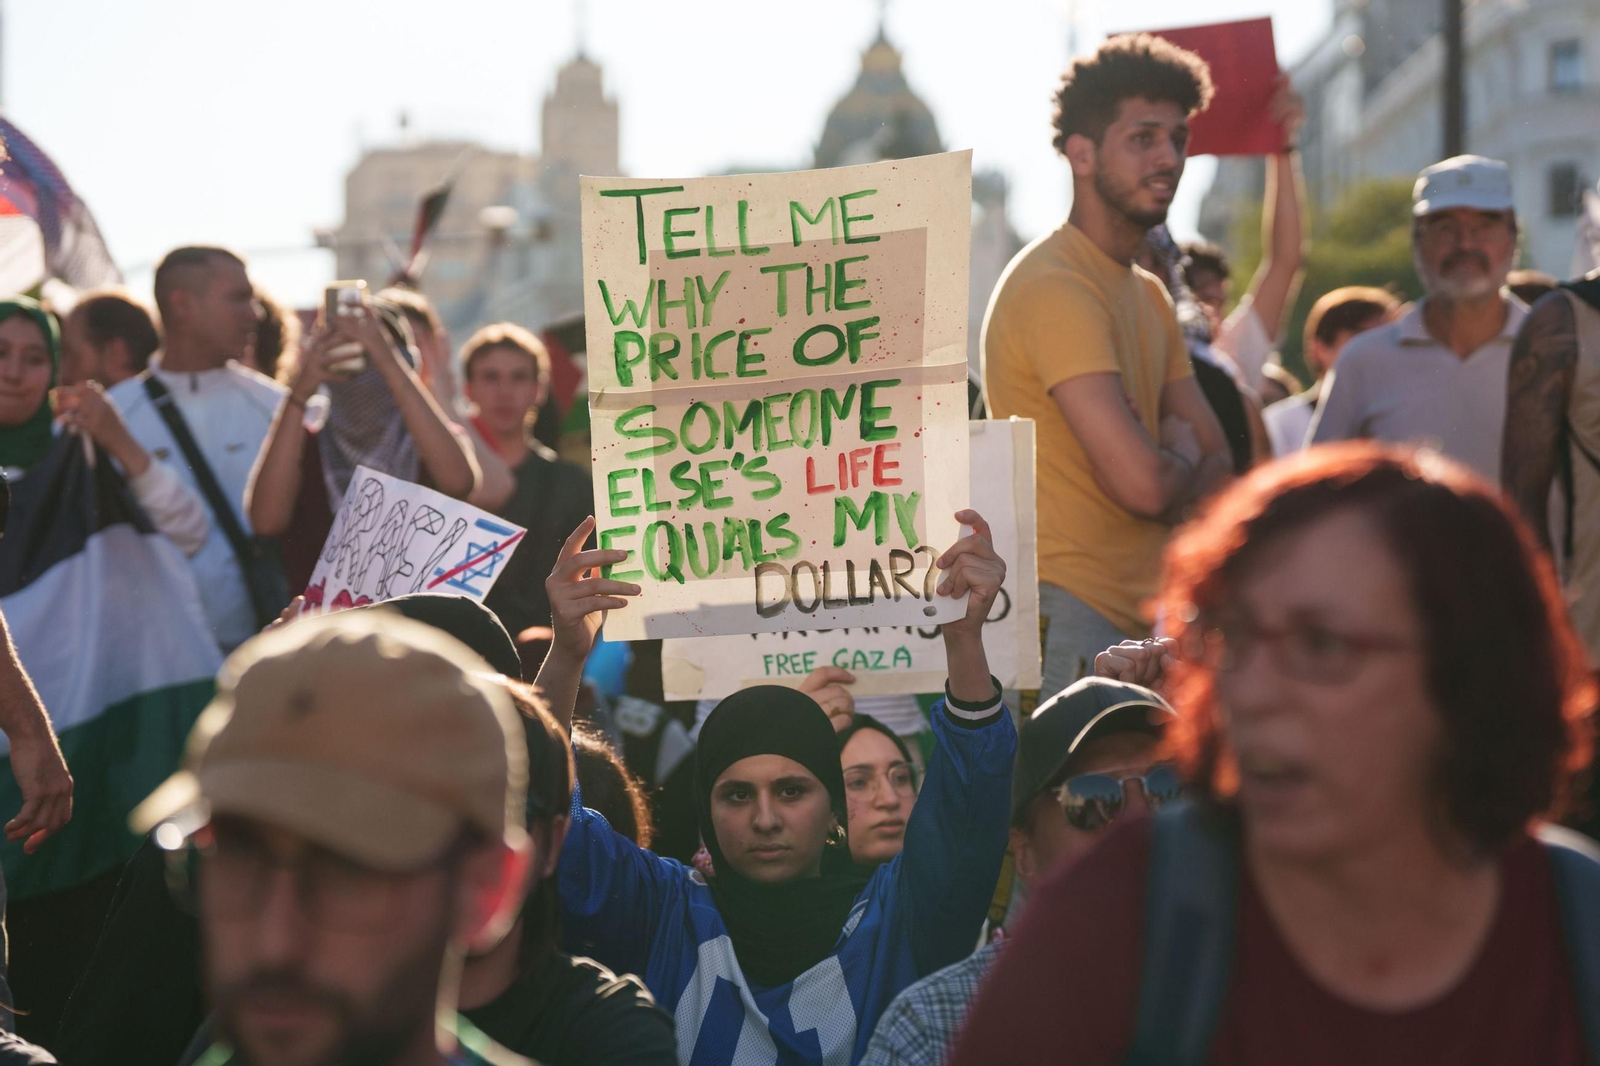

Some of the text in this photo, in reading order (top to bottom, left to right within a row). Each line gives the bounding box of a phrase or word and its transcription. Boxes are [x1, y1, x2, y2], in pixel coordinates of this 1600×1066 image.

[600, 186, 880, 265] TELL ME
[598, 255, 872, 329] WHY THE
[614, 316, 880, 387] PRICE OF
[614, 379, 901, 460] SOMEONE
[607, 443, 903, 516] ELSE'S LIFE
[600, 491, 921, 585] EQUALS MY
[754, 546, 941, 618] DOLLAR?
[763, 646, 912, 676] FREE GAZA
